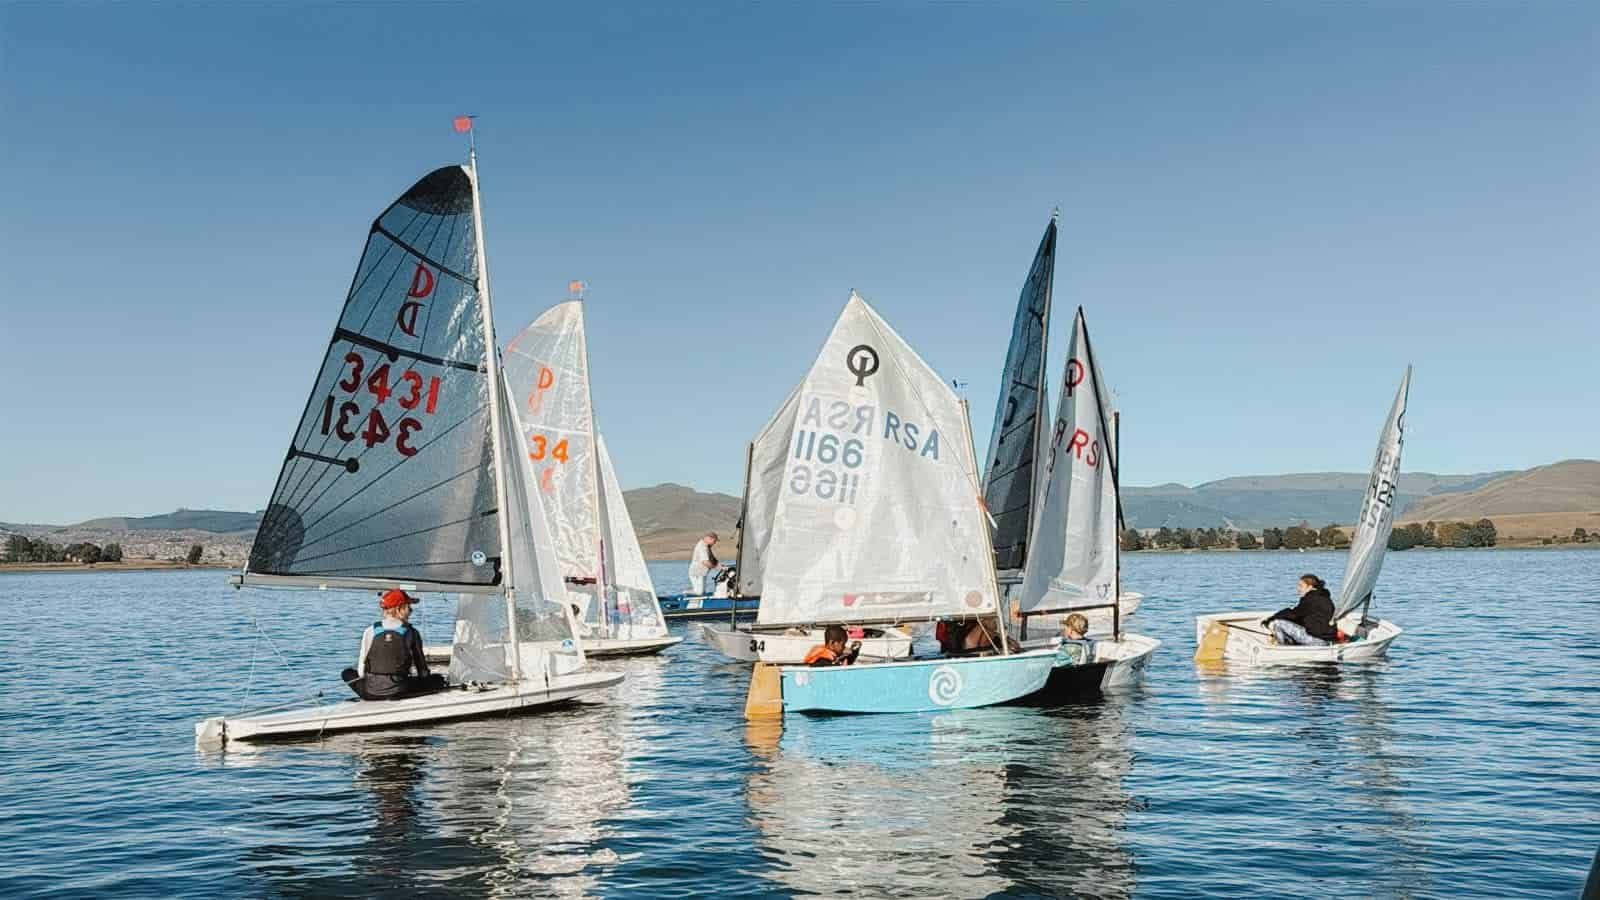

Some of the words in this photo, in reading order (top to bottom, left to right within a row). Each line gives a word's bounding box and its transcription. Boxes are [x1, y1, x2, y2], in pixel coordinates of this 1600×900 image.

[408, 263, 434, 298] D
[339, 352, 442, 415] 3431
[537, 366, 554, 390] D
[795, 430, 864, 469] 1166
[883, 411, 939, 460] RSA
[750, 639, 765, 652] 34
